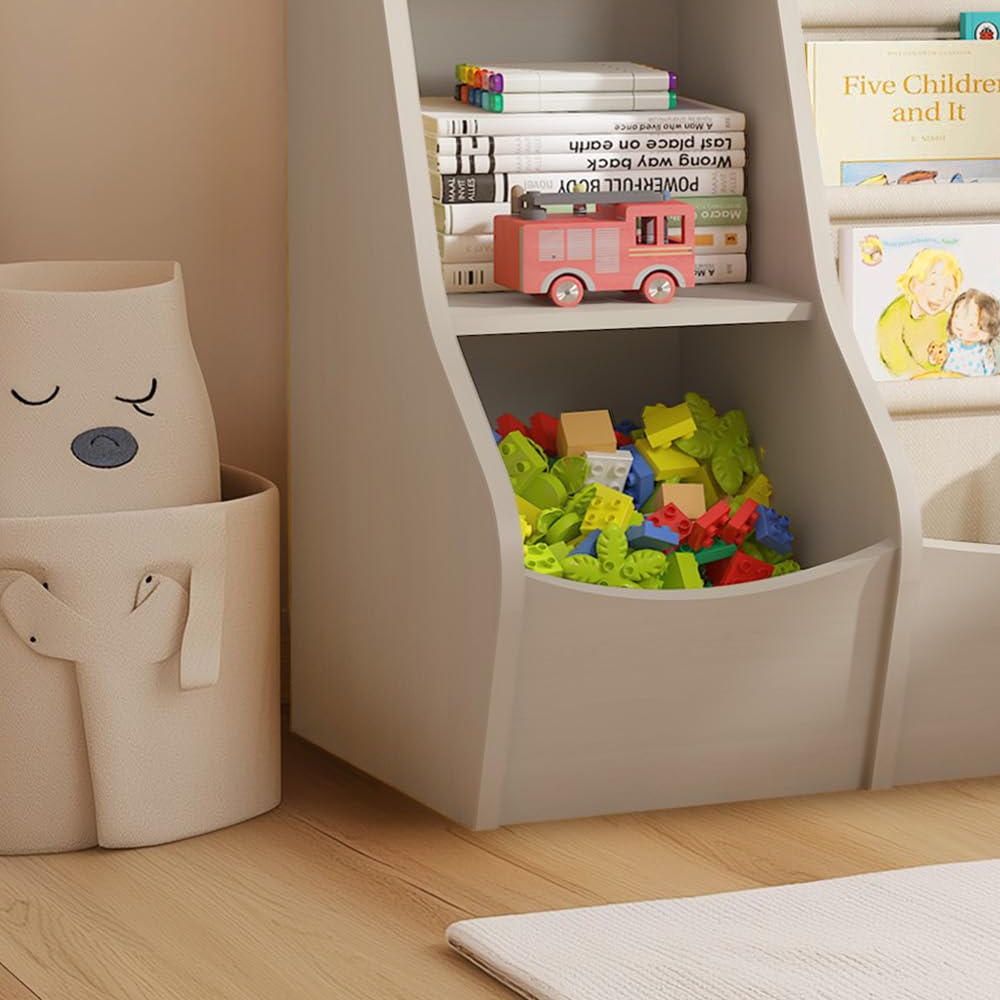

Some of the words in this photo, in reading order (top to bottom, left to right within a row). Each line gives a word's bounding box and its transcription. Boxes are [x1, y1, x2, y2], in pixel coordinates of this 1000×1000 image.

[843, 74, 897, 96] Five
[891, 101, 942, 122] and
[948, 101, 966, 121] It
[639, 123, 662, 131] lived
[663, 123, 686, 131] who
[569, 139, 613, 153] earth
[619, 139, 641, 149] on
[646, 135, 695, 150] place
[701, 137, 732, 149] Last
[587, 157, 632, 171] back
[637, 154, 673, 168] way
[679, 153, 732, 169] Wrong
[467, 178, 476, 201] ALLES
[701, 210, 742, 219] Macro
